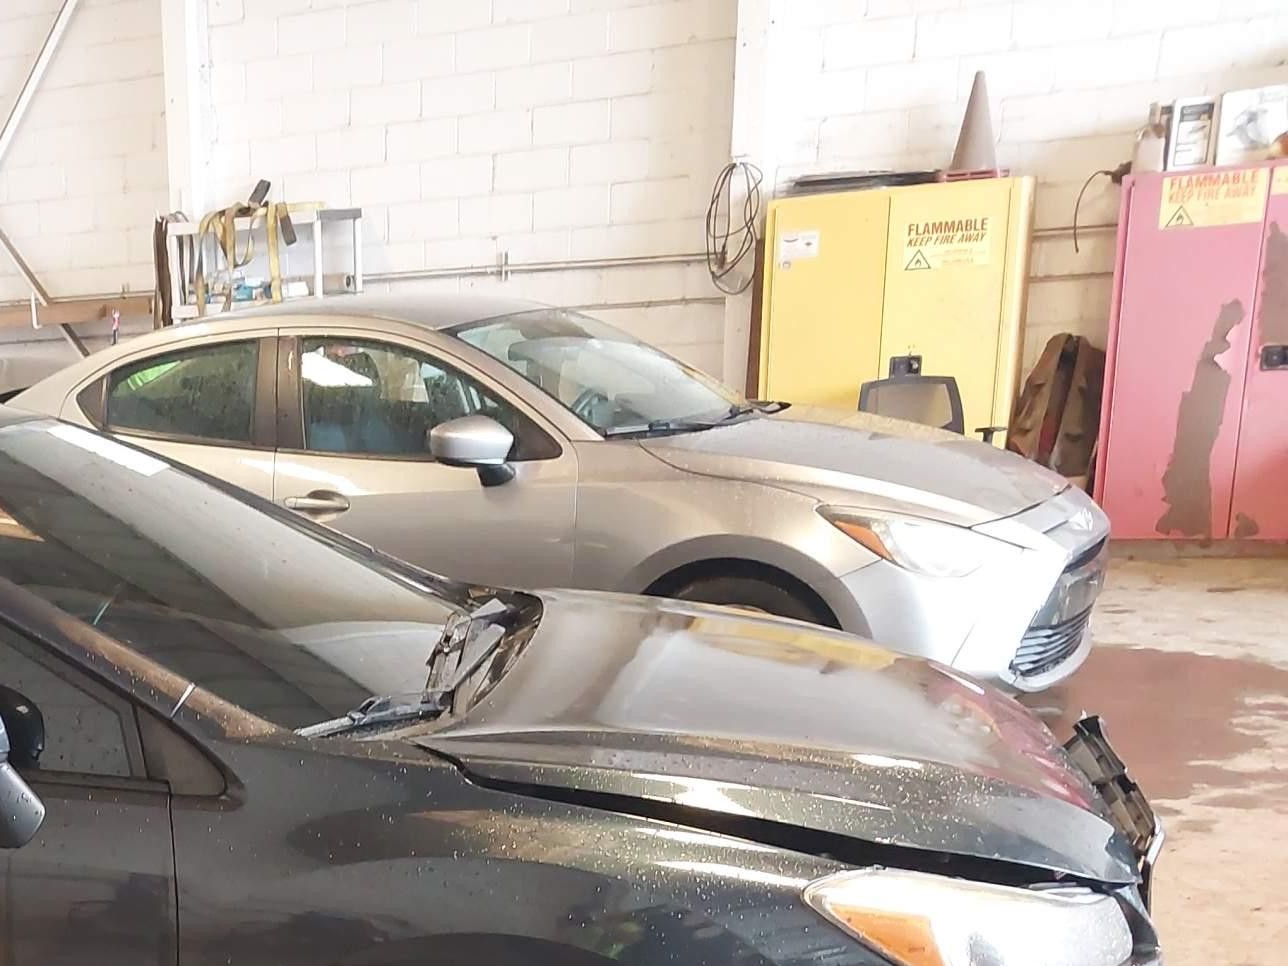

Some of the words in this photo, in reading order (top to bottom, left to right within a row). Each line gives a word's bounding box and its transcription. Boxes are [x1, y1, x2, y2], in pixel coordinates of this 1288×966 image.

[907, 217, 988, 236] FLAMMABLE
[907, 236, 932, 247] KEEP
[934, 234, 956, 245] FIRE
[958, 232, 986, 243] AWAY
